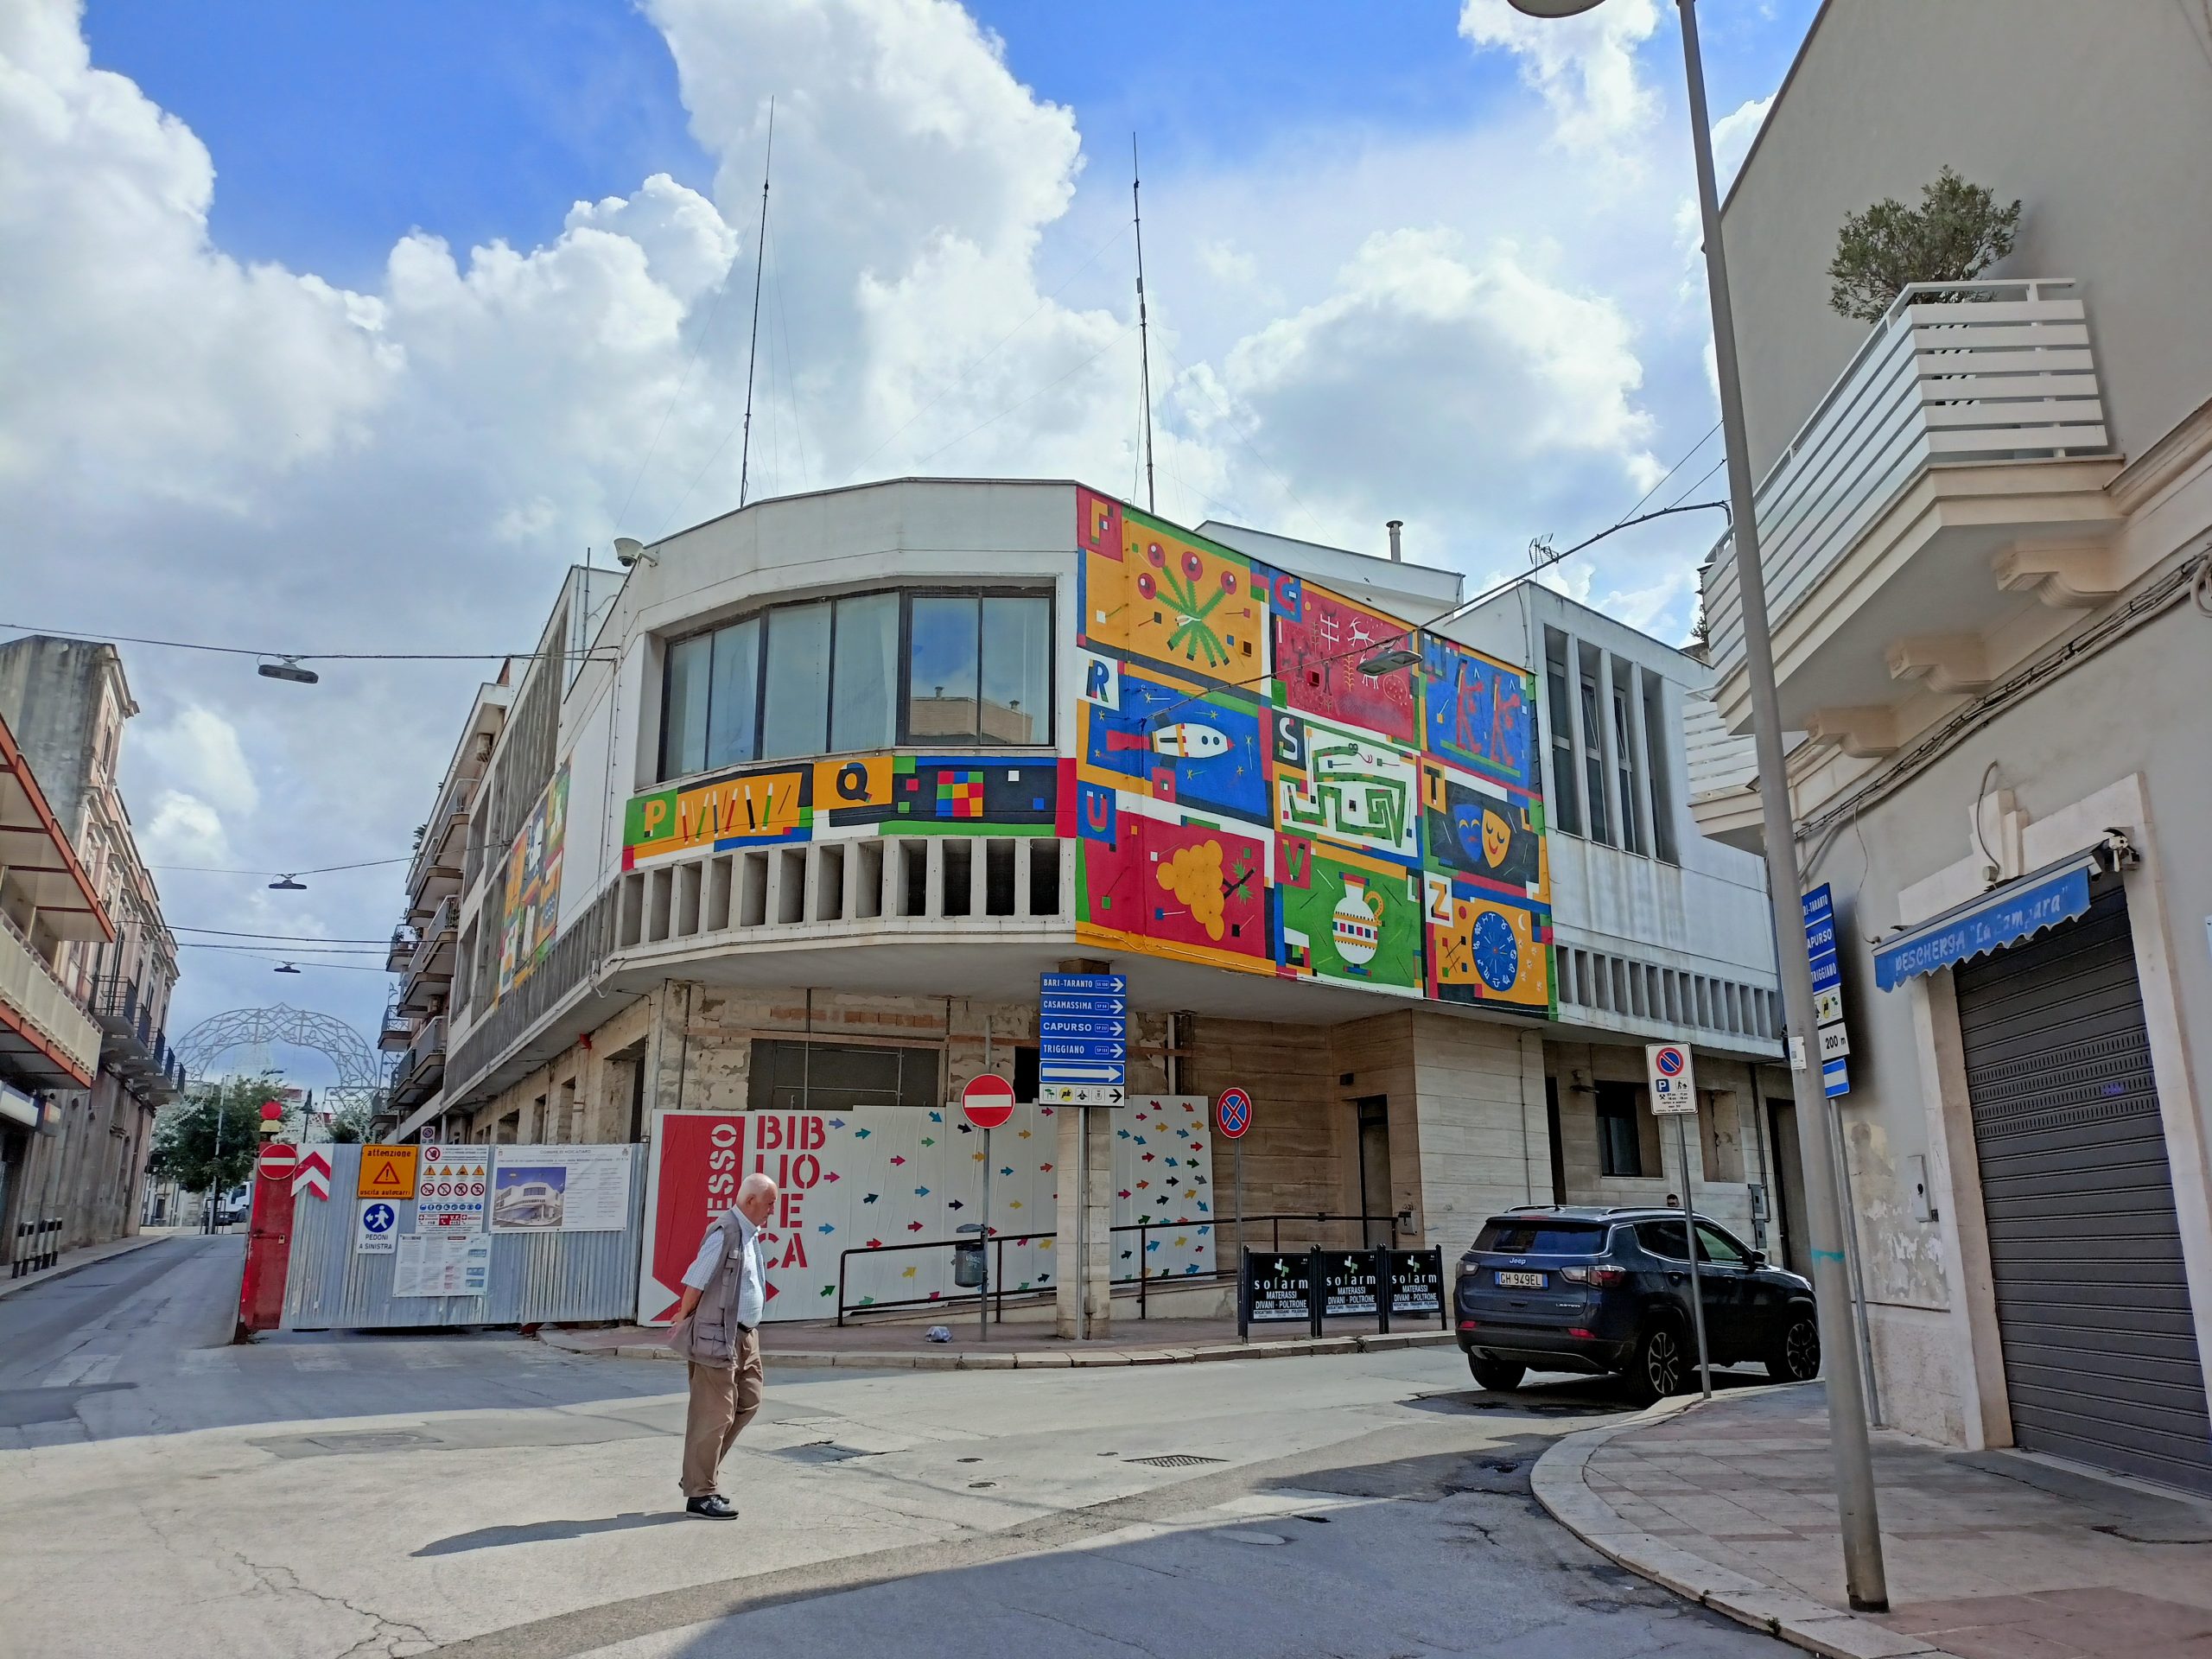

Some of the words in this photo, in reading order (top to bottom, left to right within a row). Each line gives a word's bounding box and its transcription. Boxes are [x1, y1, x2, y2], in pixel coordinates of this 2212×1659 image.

[1086, 658, 1109, 703] R
[1278, 716, 1299, 761] S
[836, 761, 873, 804] Q
[1423, 764, 1443, 805] T
[643, 799, 667, 838] P
[1086, 790, 1108, 834] U
[1281, 838, 1306, 881] V
[1428, 880, 1450, 921] Z
[1803, 893, 1828, 917] RI-TARANTO
[1807, 928, 1833, 950] APURSO
[1043, 978, 1093, 988] BARI-TARANTO
[1043, 1001, 1092, 1010] CASAMASSIMA
[1043, 1022, 1092, 1032] CAPURSO
[1043, 1044, 1085, 1054] TRIGGIANO
[1825, 1034, 1839, 1050] 200
[1840, 1037, 1846, 1046] m
[755, 1115, 826, 1150] BIB
[367, 1148, 411, 1158] attenzione
[706, 1123, 738, 1219] ESSO
[1509, 1257, 1527, 1266] Jeep
[1514, 1274, 1541, 1286] 949EL
[1266, 1290, 1298, 1300] MATERASSI
[1338, 1286, 1366, 1295] MATERASSI
[1402, 1285, 1428, 1294] MATERASSI
[1255, 1300, 1274, 1309] DIVANI
[1279, 1300, 1307, 1309] POLTRONE
[1327, 1296, 1345, 1305] DIVANI
[1349, 1294, 1376, 1303] POLTRONE
[1394, 1294, 1410, 1302] DIVANI
[1413, 1293, 1437, 1301] POLTRONE
